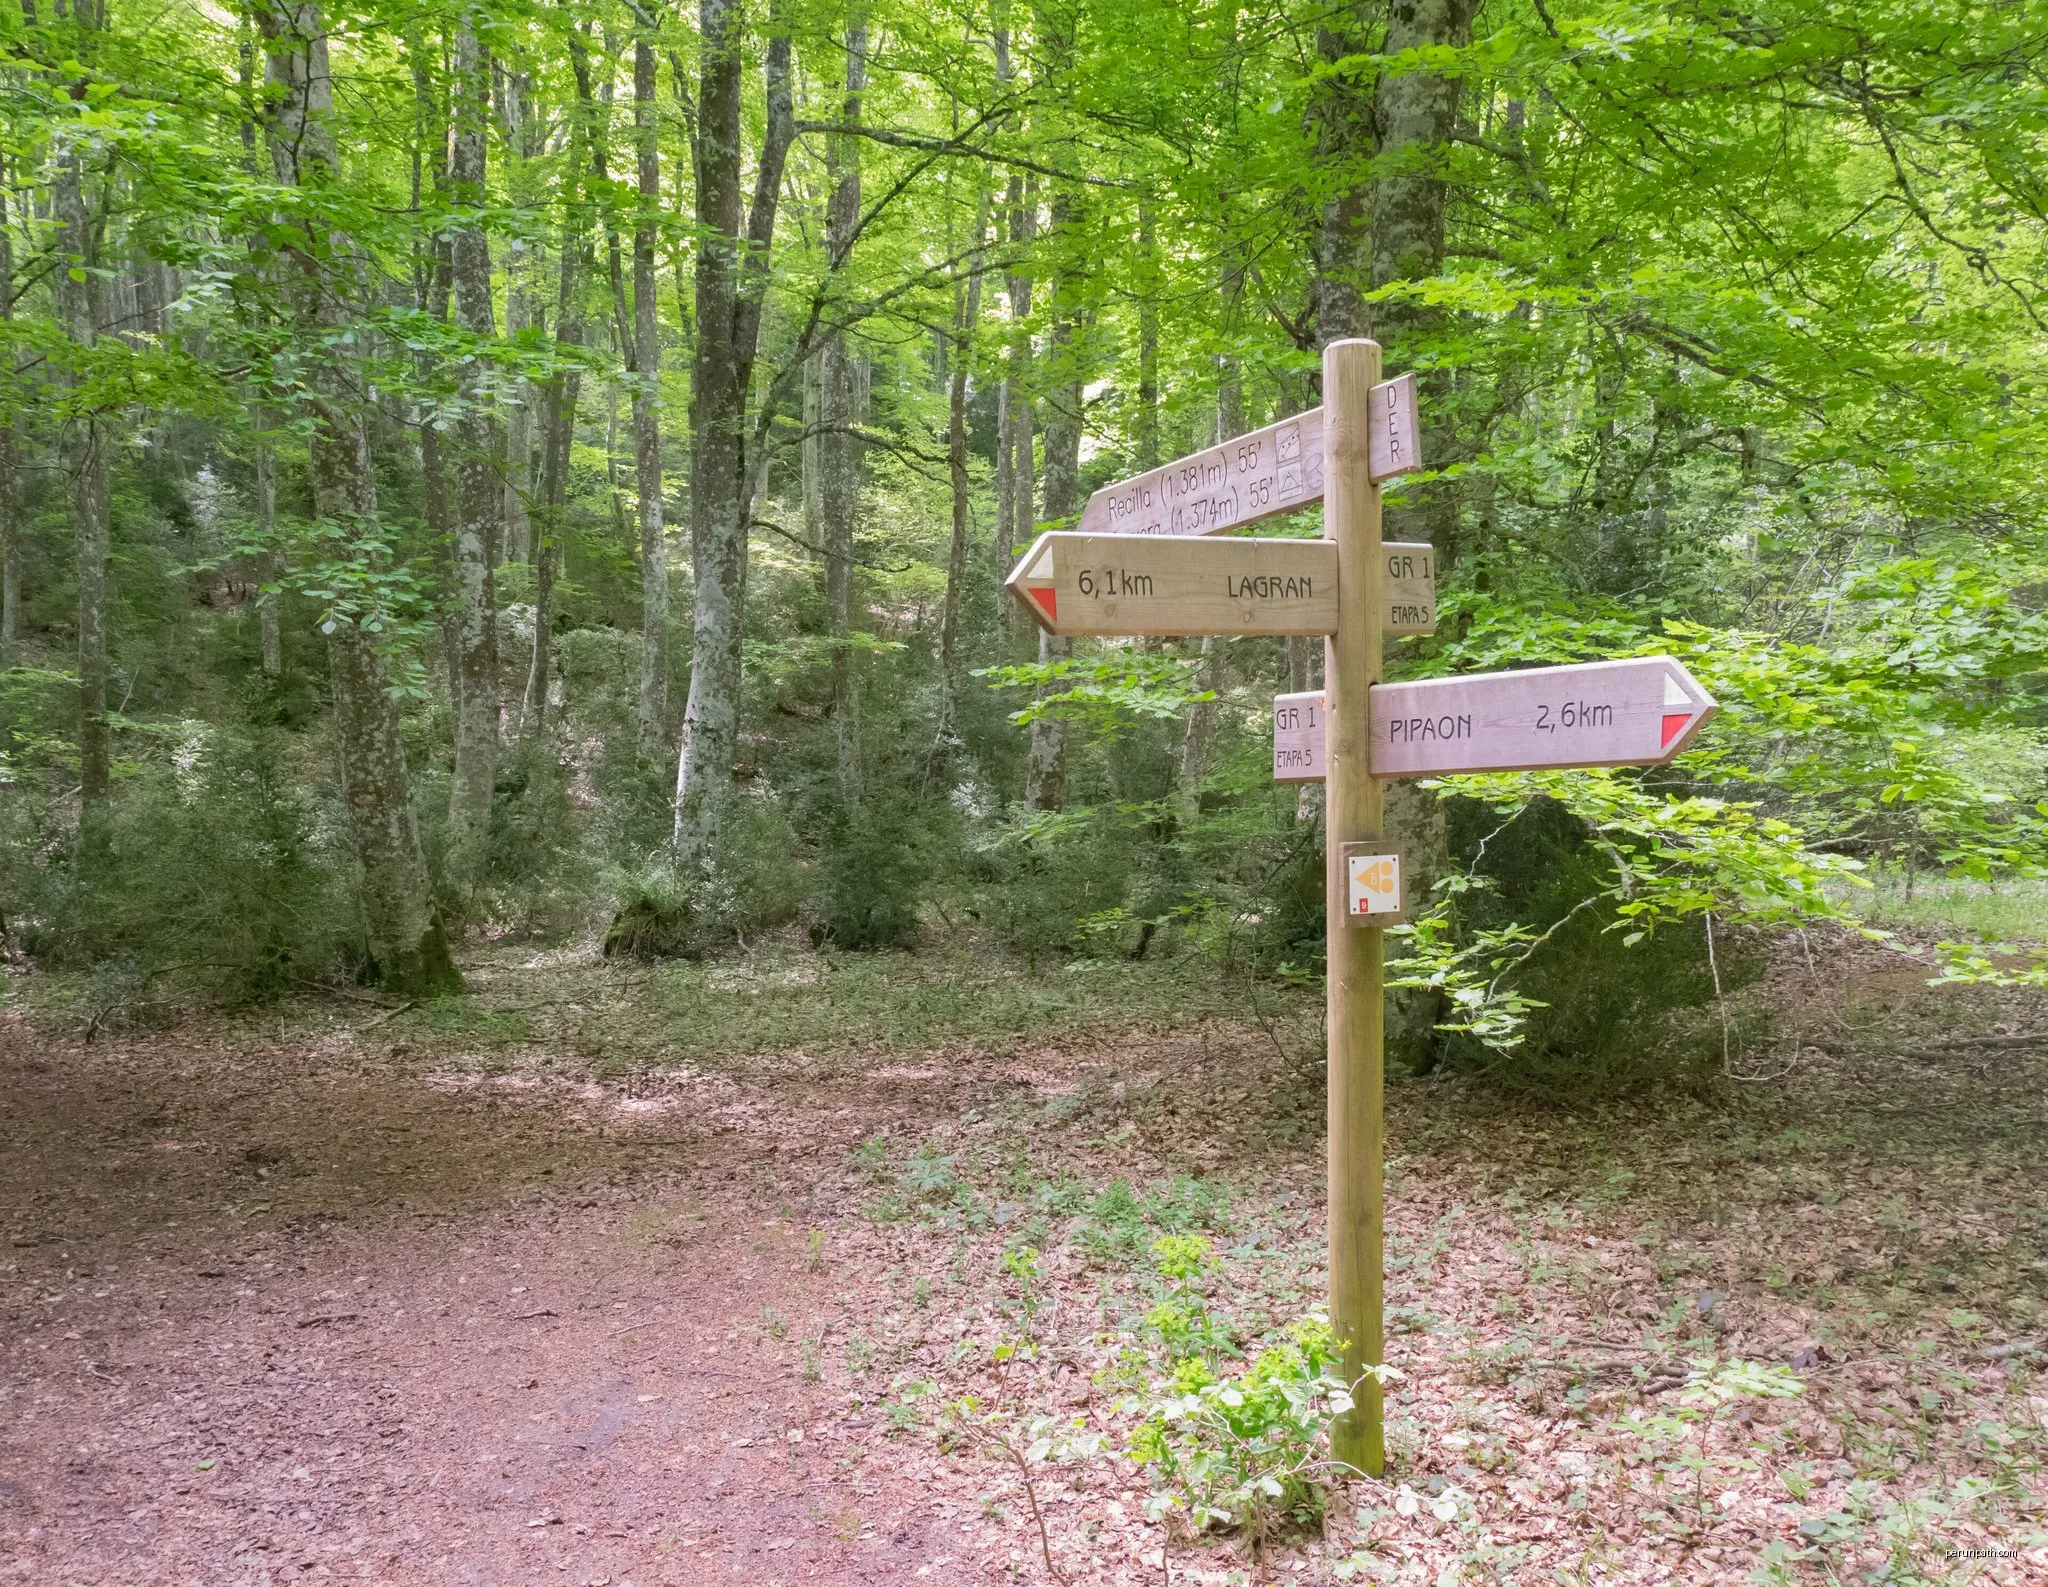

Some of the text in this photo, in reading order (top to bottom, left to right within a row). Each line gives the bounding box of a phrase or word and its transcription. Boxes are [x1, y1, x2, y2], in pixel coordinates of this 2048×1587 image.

[1108, 487, 1151, 521] Recilla
[1160, 451, 1228, 507] (1.381m)
[1170, 485, 1239, 535] (1.374m)
[1388, 555, 1430, 579] GR 1
[1078, 568, 1312, 600] 6,1km LAGRAN
[1391, 605, 1429, 624] ETAPA 5
[1276, 706, 1316, 730] GR 1
[1390, 701, 1613, 743] PIPAON 2,6km
[1277, 749, 1312, 768] ETAPA 5
